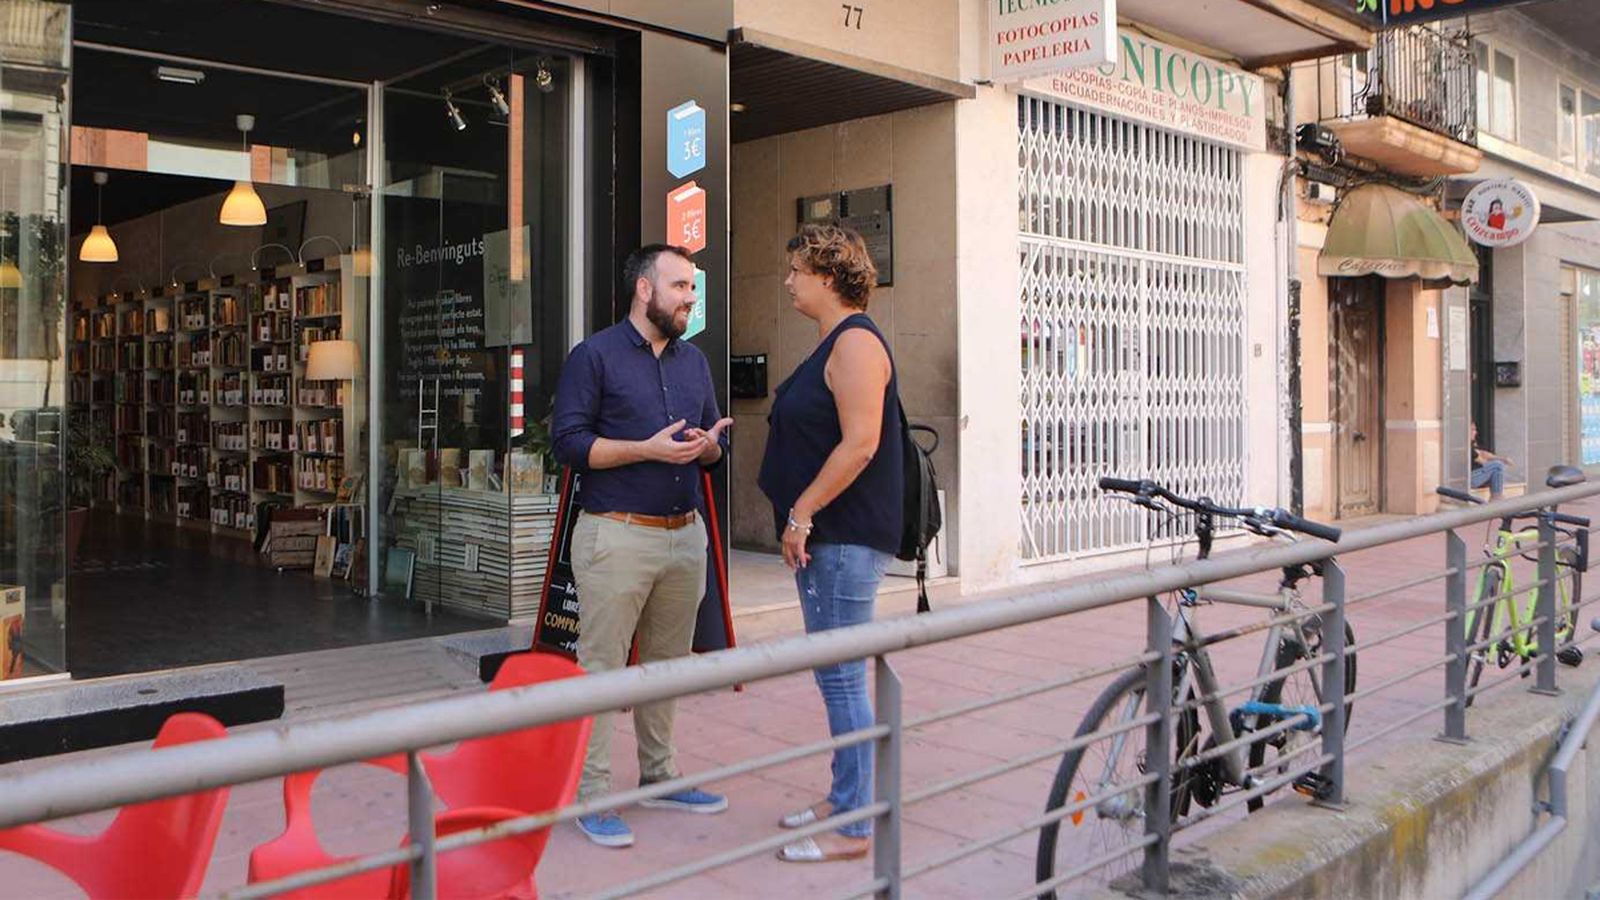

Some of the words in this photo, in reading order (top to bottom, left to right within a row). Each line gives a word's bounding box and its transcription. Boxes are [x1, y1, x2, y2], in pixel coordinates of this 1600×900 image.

[842, 3, 863, 30] 77
[997, 11, 1100, 45] FOTOCOPIAS
[1003, 37, 1091, 66] PAPELERIA
[1052, 78, 1166, 121] ENCUADERNACIONES
[1169, 111, 1177, 123] Y
[1152, 92, 1167, 108] DE
[683, 137, 703, 161] 3€
[683, 218, 703, 243] 5€
[396, 237, 485, 268] Re-Benvinguts
